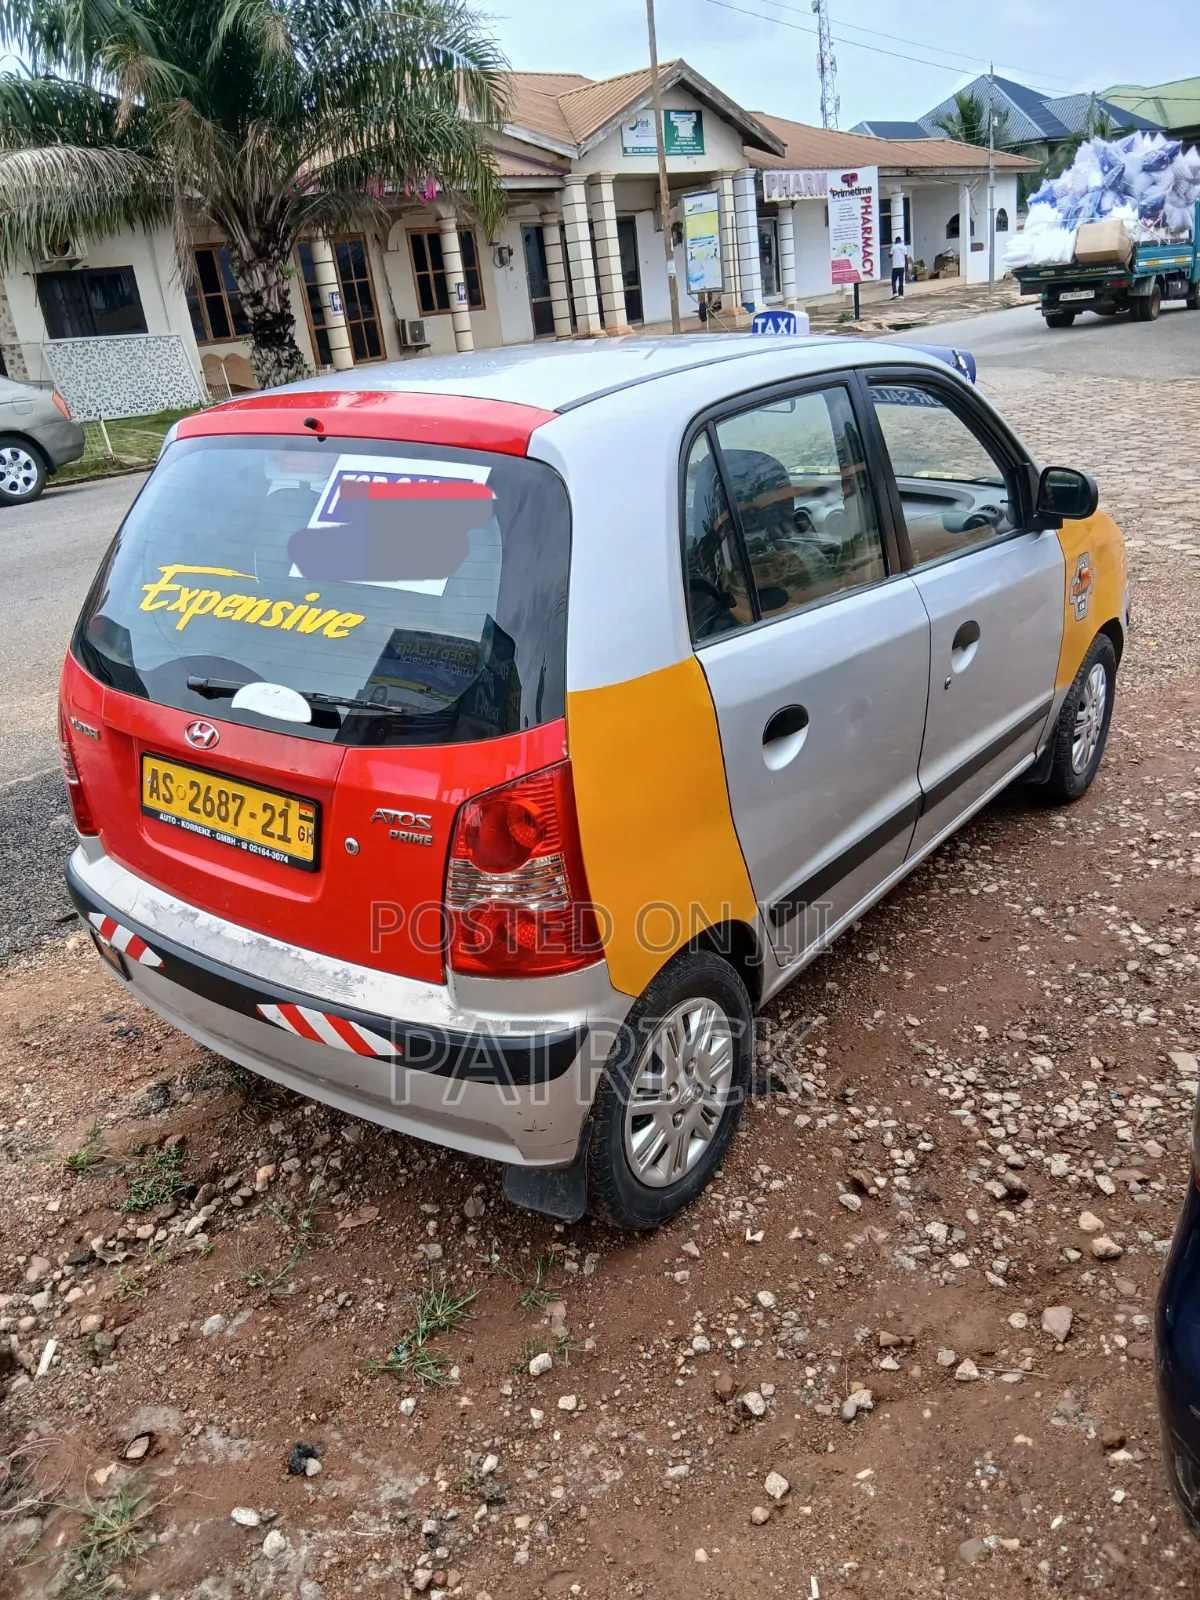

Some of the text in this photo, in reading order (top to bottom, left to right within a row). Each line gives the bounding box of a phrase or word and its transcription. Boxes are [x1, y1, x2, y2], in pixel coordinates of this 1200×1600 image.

[832, 186, 873, 199] Primetime
[861, 196, 875, 277] PHARMACY
[754, 317, 795, 335] TAXI
[139, 564, 367, 639] Expensive
[149, 768, 292, 844] AS 2687-21
[370, 807, 433, 831] ATOS
[159, 812, 289, 864] AUTO KORRENZ GMBH 02164-3074
[388, 829, 434, 847] PRIME
